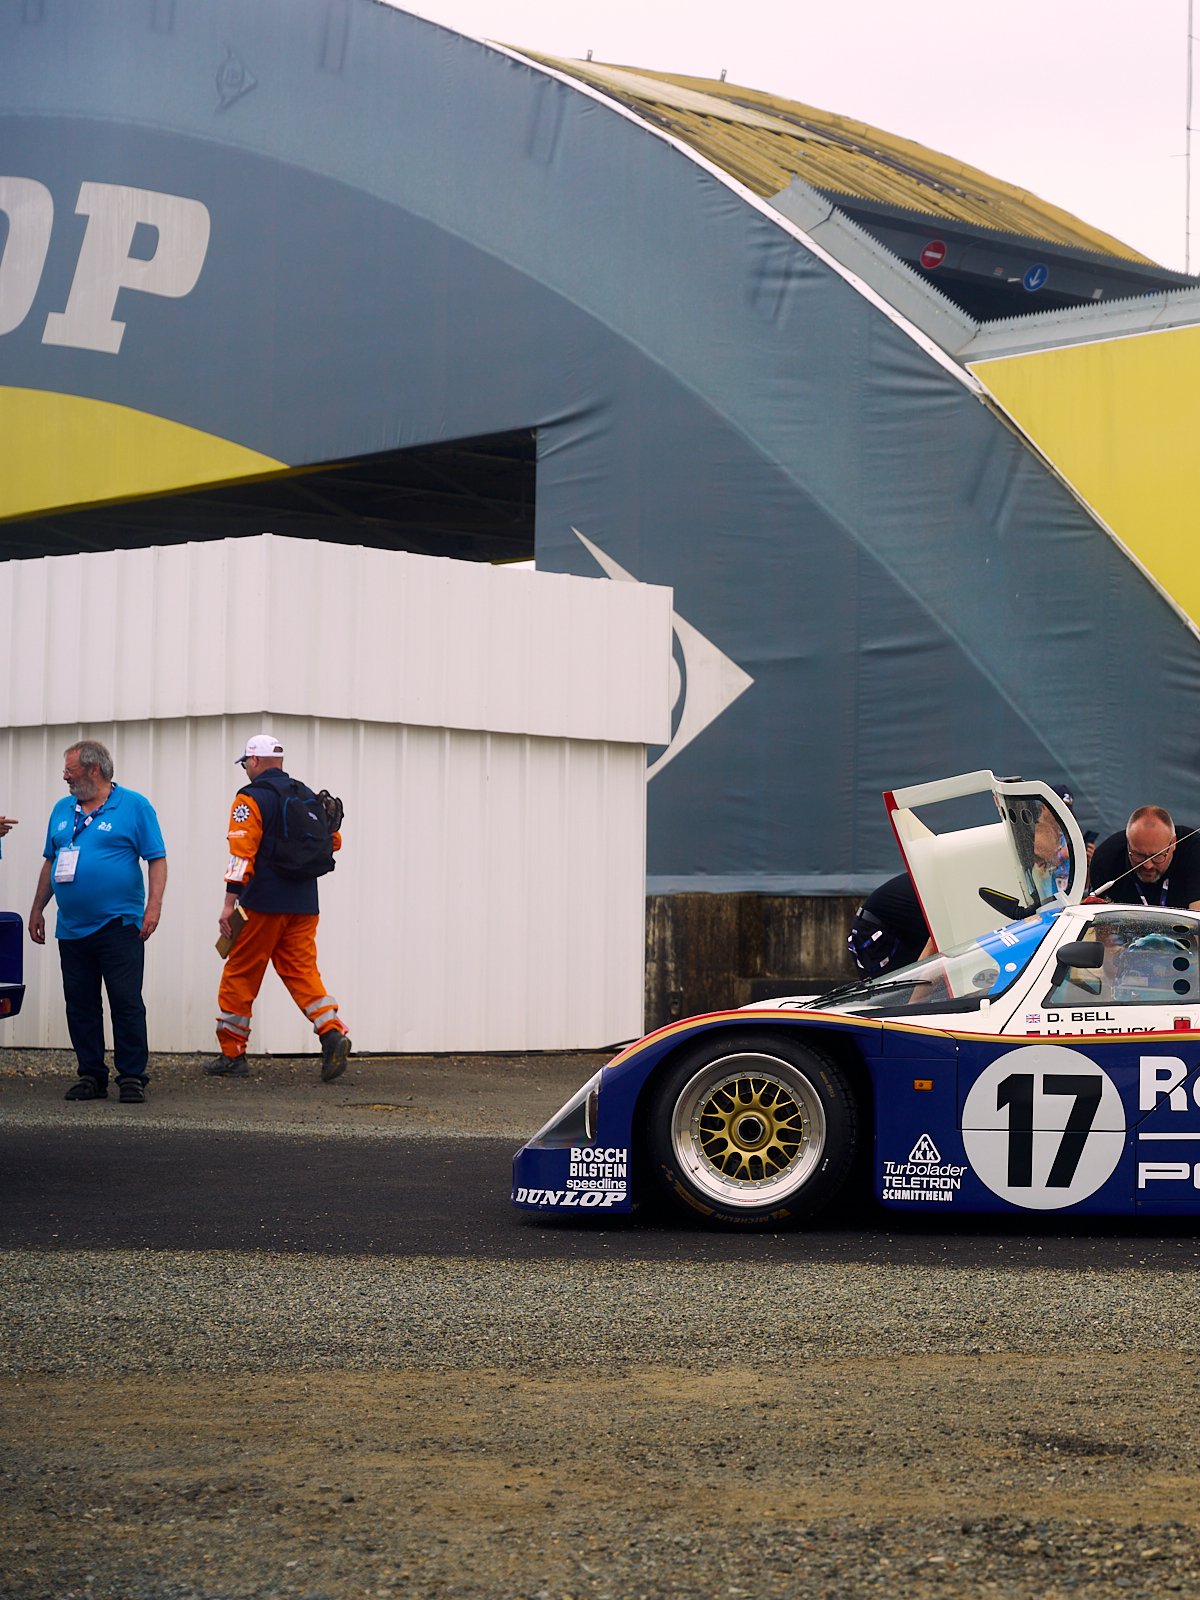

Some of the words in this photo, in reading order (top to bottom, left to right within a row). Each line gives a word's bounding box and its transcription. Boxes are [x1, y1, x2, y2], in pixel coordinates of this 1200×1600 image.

[1047, 1013, 1064, 1022] D.
[1071, 1012, 1115, 1022] BELL
[997, 1072, 1103, 1189] 17
[570, 1147, 628, 1163] BOSCH
[569, 1163, 627, 1178] BILSTEIN
[883, 1161, 967, 1176] Turbolader
[566, 1178, 627, 1191] speedline
[882, 1175, 961, 1190] TELETRON
[515, 1187, 627, 1207] DUNLOP
[882, 1188, 953, 1202] SCHMITTHELM
